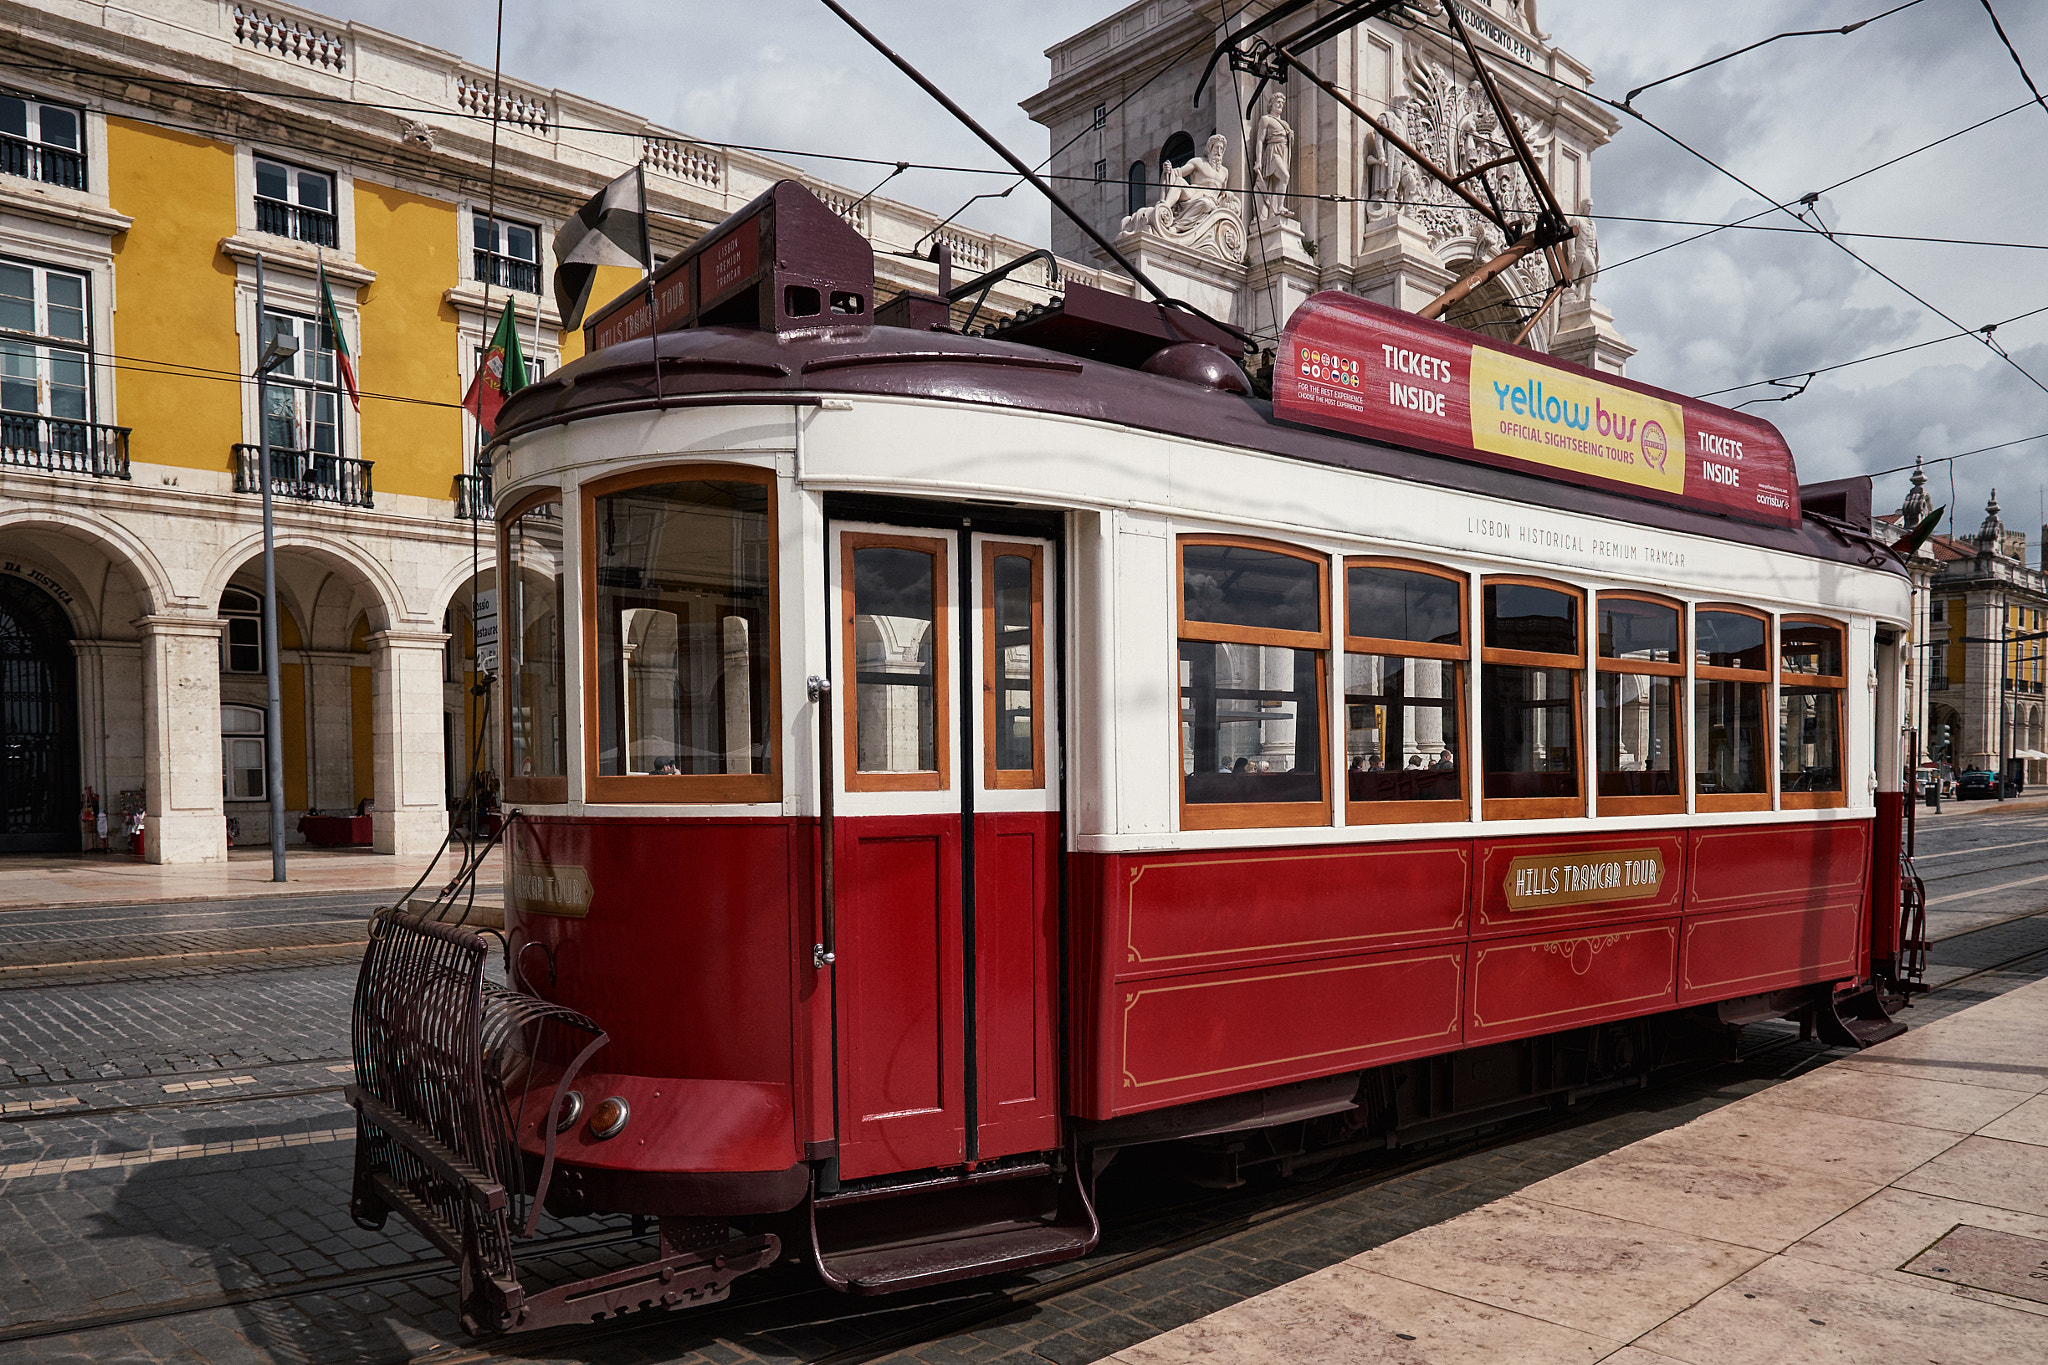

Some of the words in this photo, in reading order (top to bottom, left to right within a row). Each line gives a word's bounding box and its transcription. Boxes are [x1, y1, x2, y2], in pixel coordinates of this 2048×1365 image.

[718, 237, 738, 260] LISBON
[716, 251, 741, 276] PREMIUM
[716, 267, 741, 291] TRAMCAR
[661, 281, 685, 317] TOUR
[1382, 343, 1451, 383] TICKETS
[1298, 382, 1309, 392] FOR
[1310, 385, 1320, 394] THE
[1320, 387, 1334, 397] BEST
[1390, 381, 1446, 417] INSIDE
[1596, 397, 1637, 443] bus
[1500, 420, 1542, 443] OFFICIAL
[1544, 431, 1604, 458] SIGHTSEEING
[1605, 446, 1635, 465] TOURS
[1698, 431, 1743, 460] TICKETS
[1703, 460, 1740, 487] INSIDE
[1468, 516, 1510, 539] LISBON
[1519, 526, 1584, 552] HISTORICAL
[1592, 539, 1637, 560] PREMIUM
[1645, 547, 1686, 568] TRAMCAR
[3, 562, 21, 573] DA
[546, 876, 583, 905] TOUR
[1515, 866, 1560, 897] HILLS
[1563, 861, 1621, 893] TRAMCAR
[1624, 858, 1657, 887] TOUR
